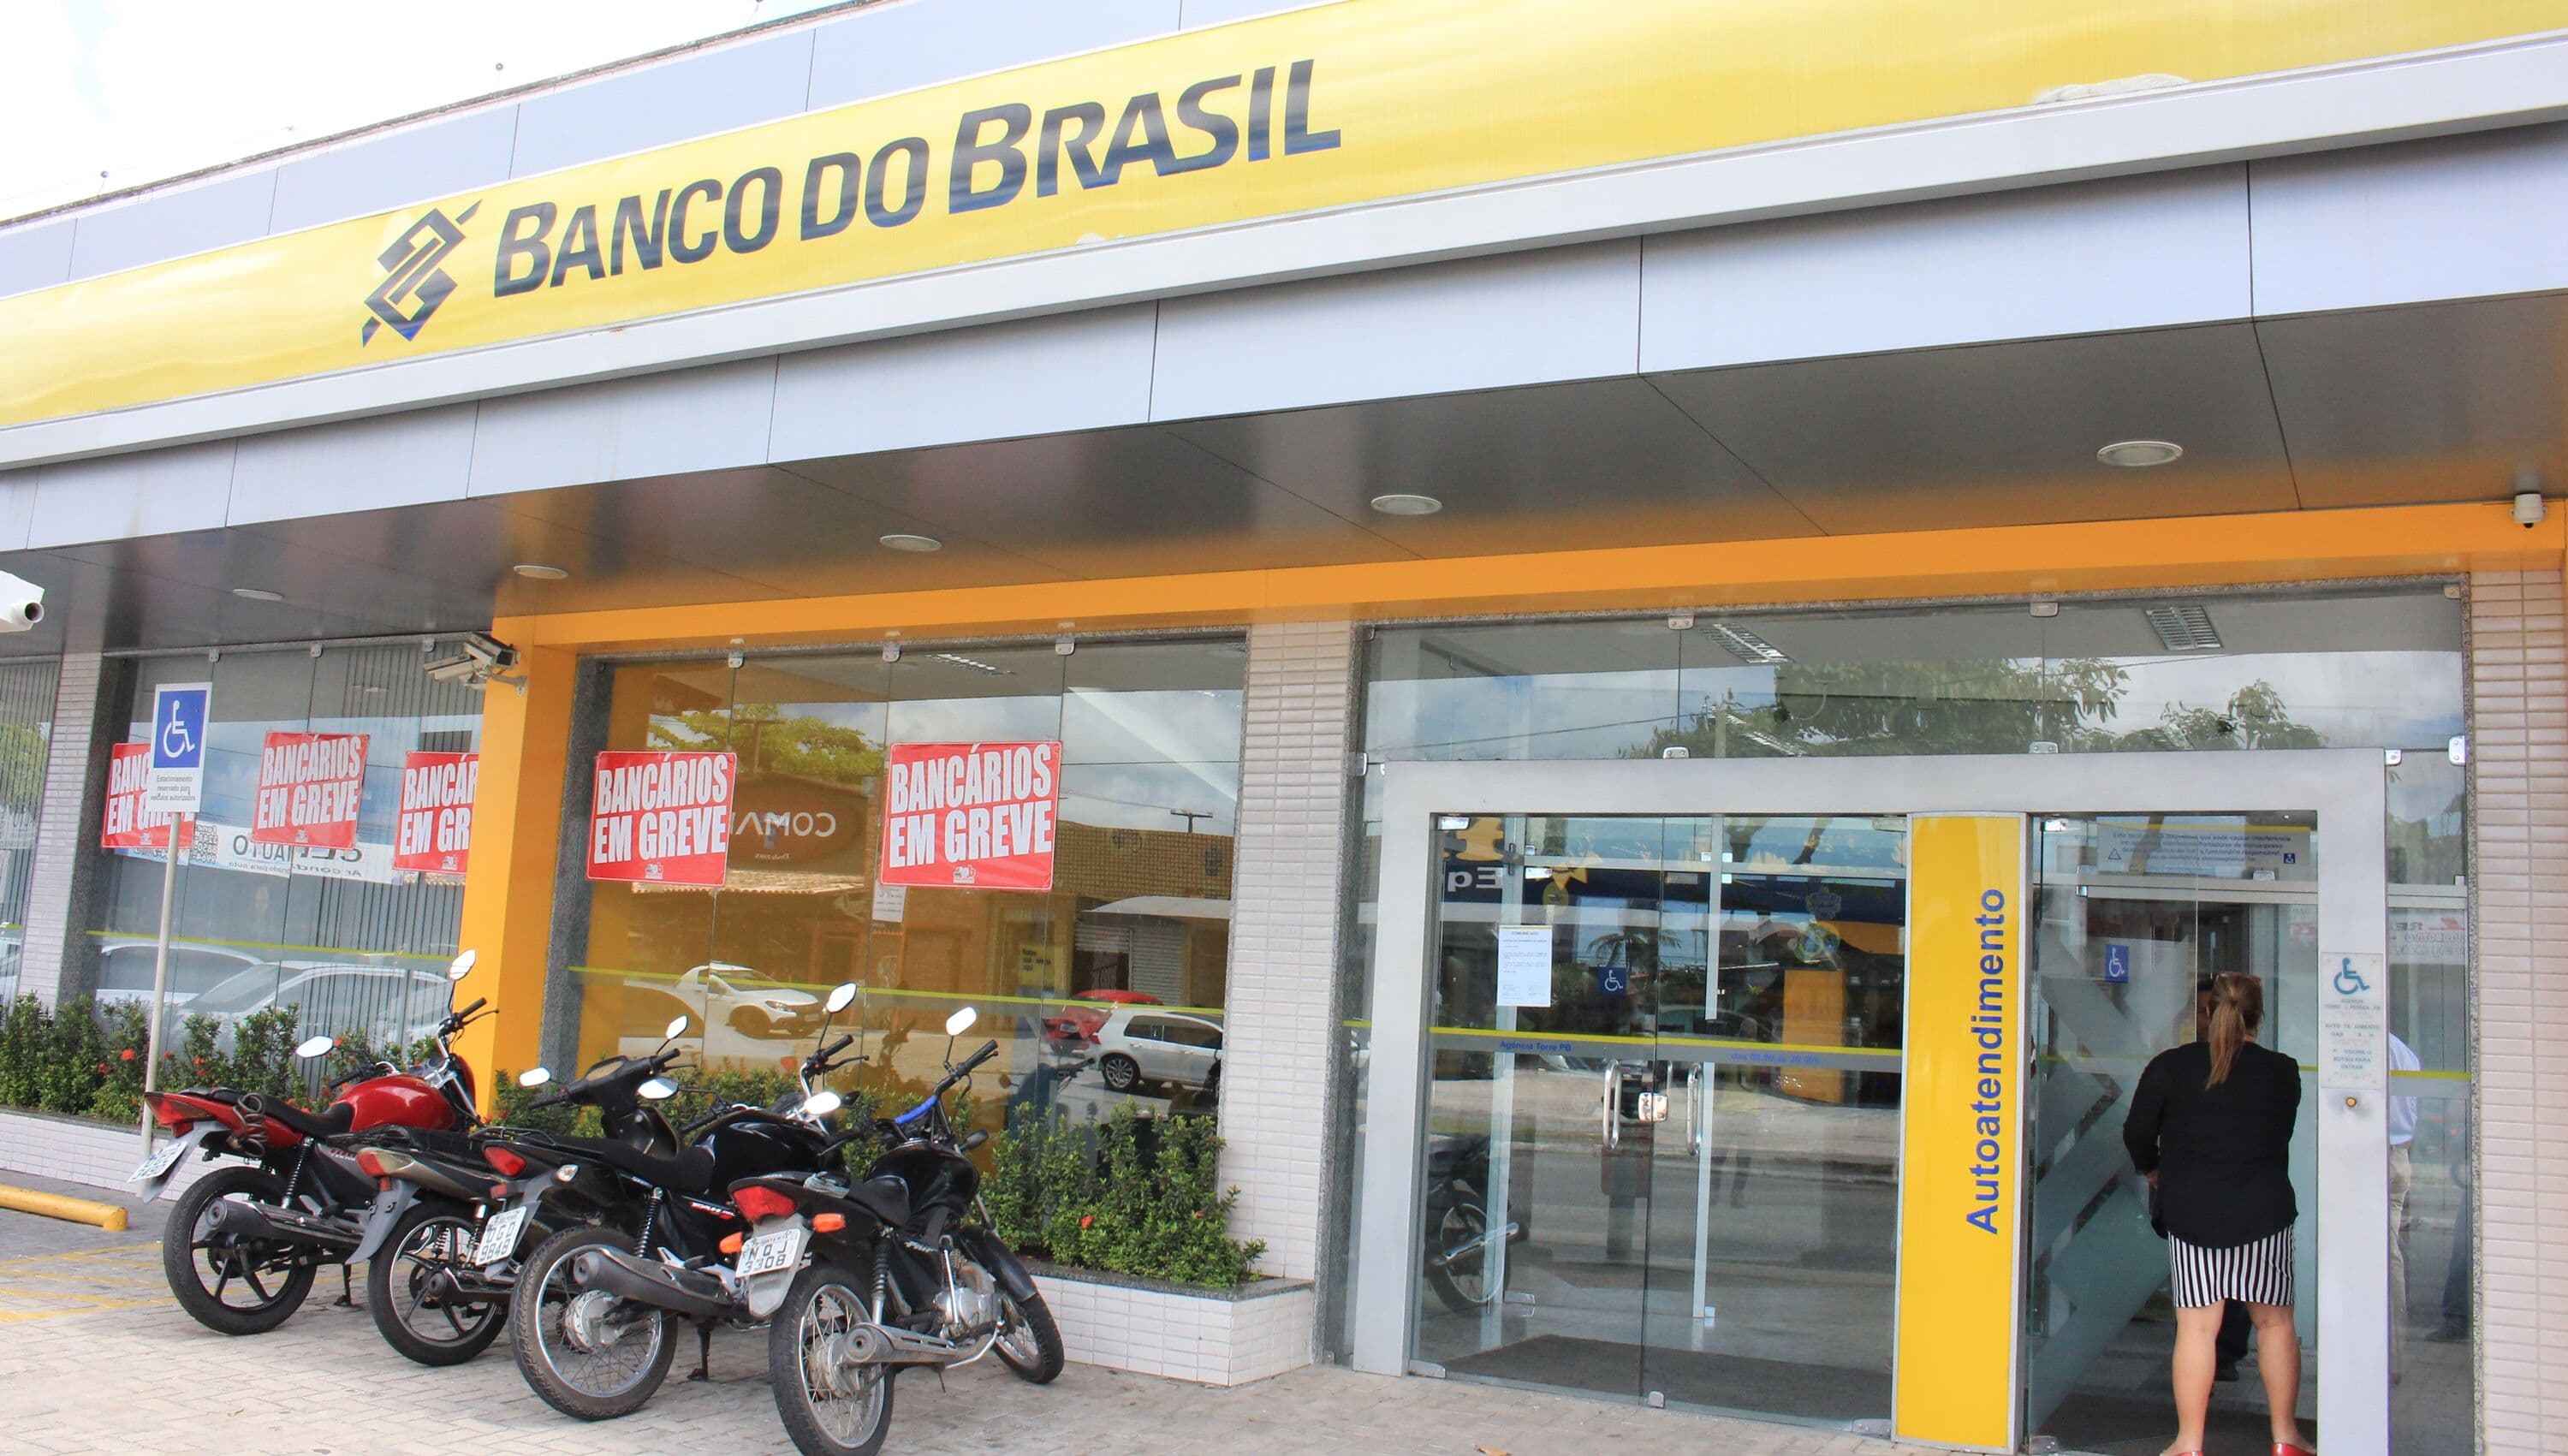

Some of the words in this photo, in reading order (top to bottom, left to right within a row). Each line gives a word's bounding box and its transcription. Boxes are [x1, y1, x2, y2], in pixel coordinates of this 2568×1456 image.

[494, 166, 782, 298] BANCO
[800, 137, 930, 241] DO
[948, 58, 1341, 215] BRASIL
[262, 734, 361, 787] BANCÁRIOS
[403, 753, 479, 811] BANCÁR
[597, 752, 728, 815] BANCÁRIOS
[891, 743, 1052, 814] BANCÁRIOS
[107, 793, 134, 835] EM
[258, 787, 288, 829] EM
[291, 780, 359, 827] GREVE
[399, 810, 434, 856] EM
[889, 813, 936, 868] EM
[944, 799, 1052, 863] GREVE
[594, 814, 633, 864] EM
[639, 805, 728, 860] GREVE
[1966, 888, 2005, 1234] Autoatendimento
